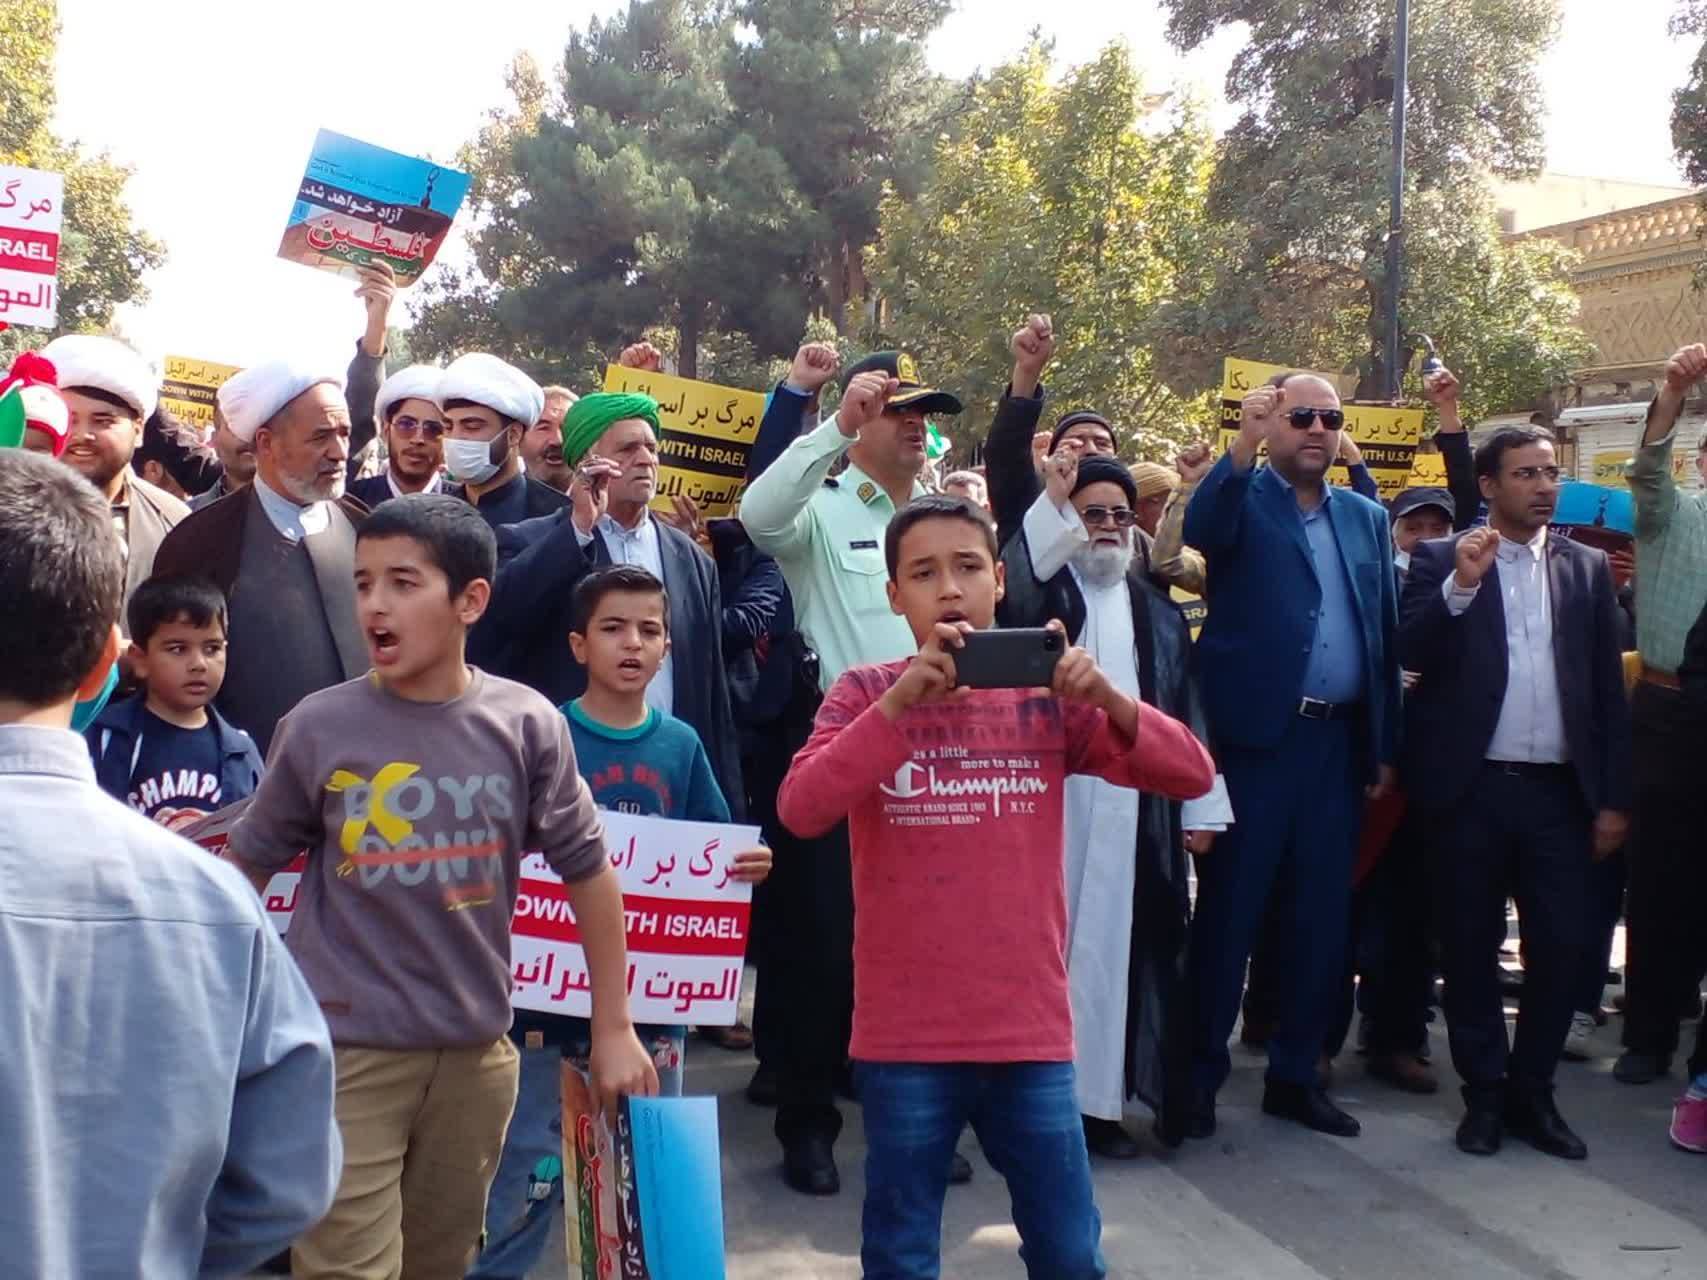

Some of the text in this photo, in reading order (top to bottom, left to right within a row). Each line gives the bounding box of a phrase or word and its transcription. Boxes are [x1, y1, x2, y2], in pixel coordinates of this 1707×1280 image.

[688, 399, 756, 434] مرگ بر
[1223, 407, 1242, 422] DO
[1387, 416, 1417, 441] مرگ
[1365, 424, 1381, 440] بر
[655, 439, 746, 467] WITH ISRAEL
[687, 482, 738, 509] الموت
[991, 758, 1006, 769] to
[343, 773, 513, 822] BOYS
[879, 761, 1048, 818] Champion
[643, 852, 676, 887] بر
[512, 894, 743, 939] OWN TH ISRAEL
[644, 967, 740, 1014] الموت
